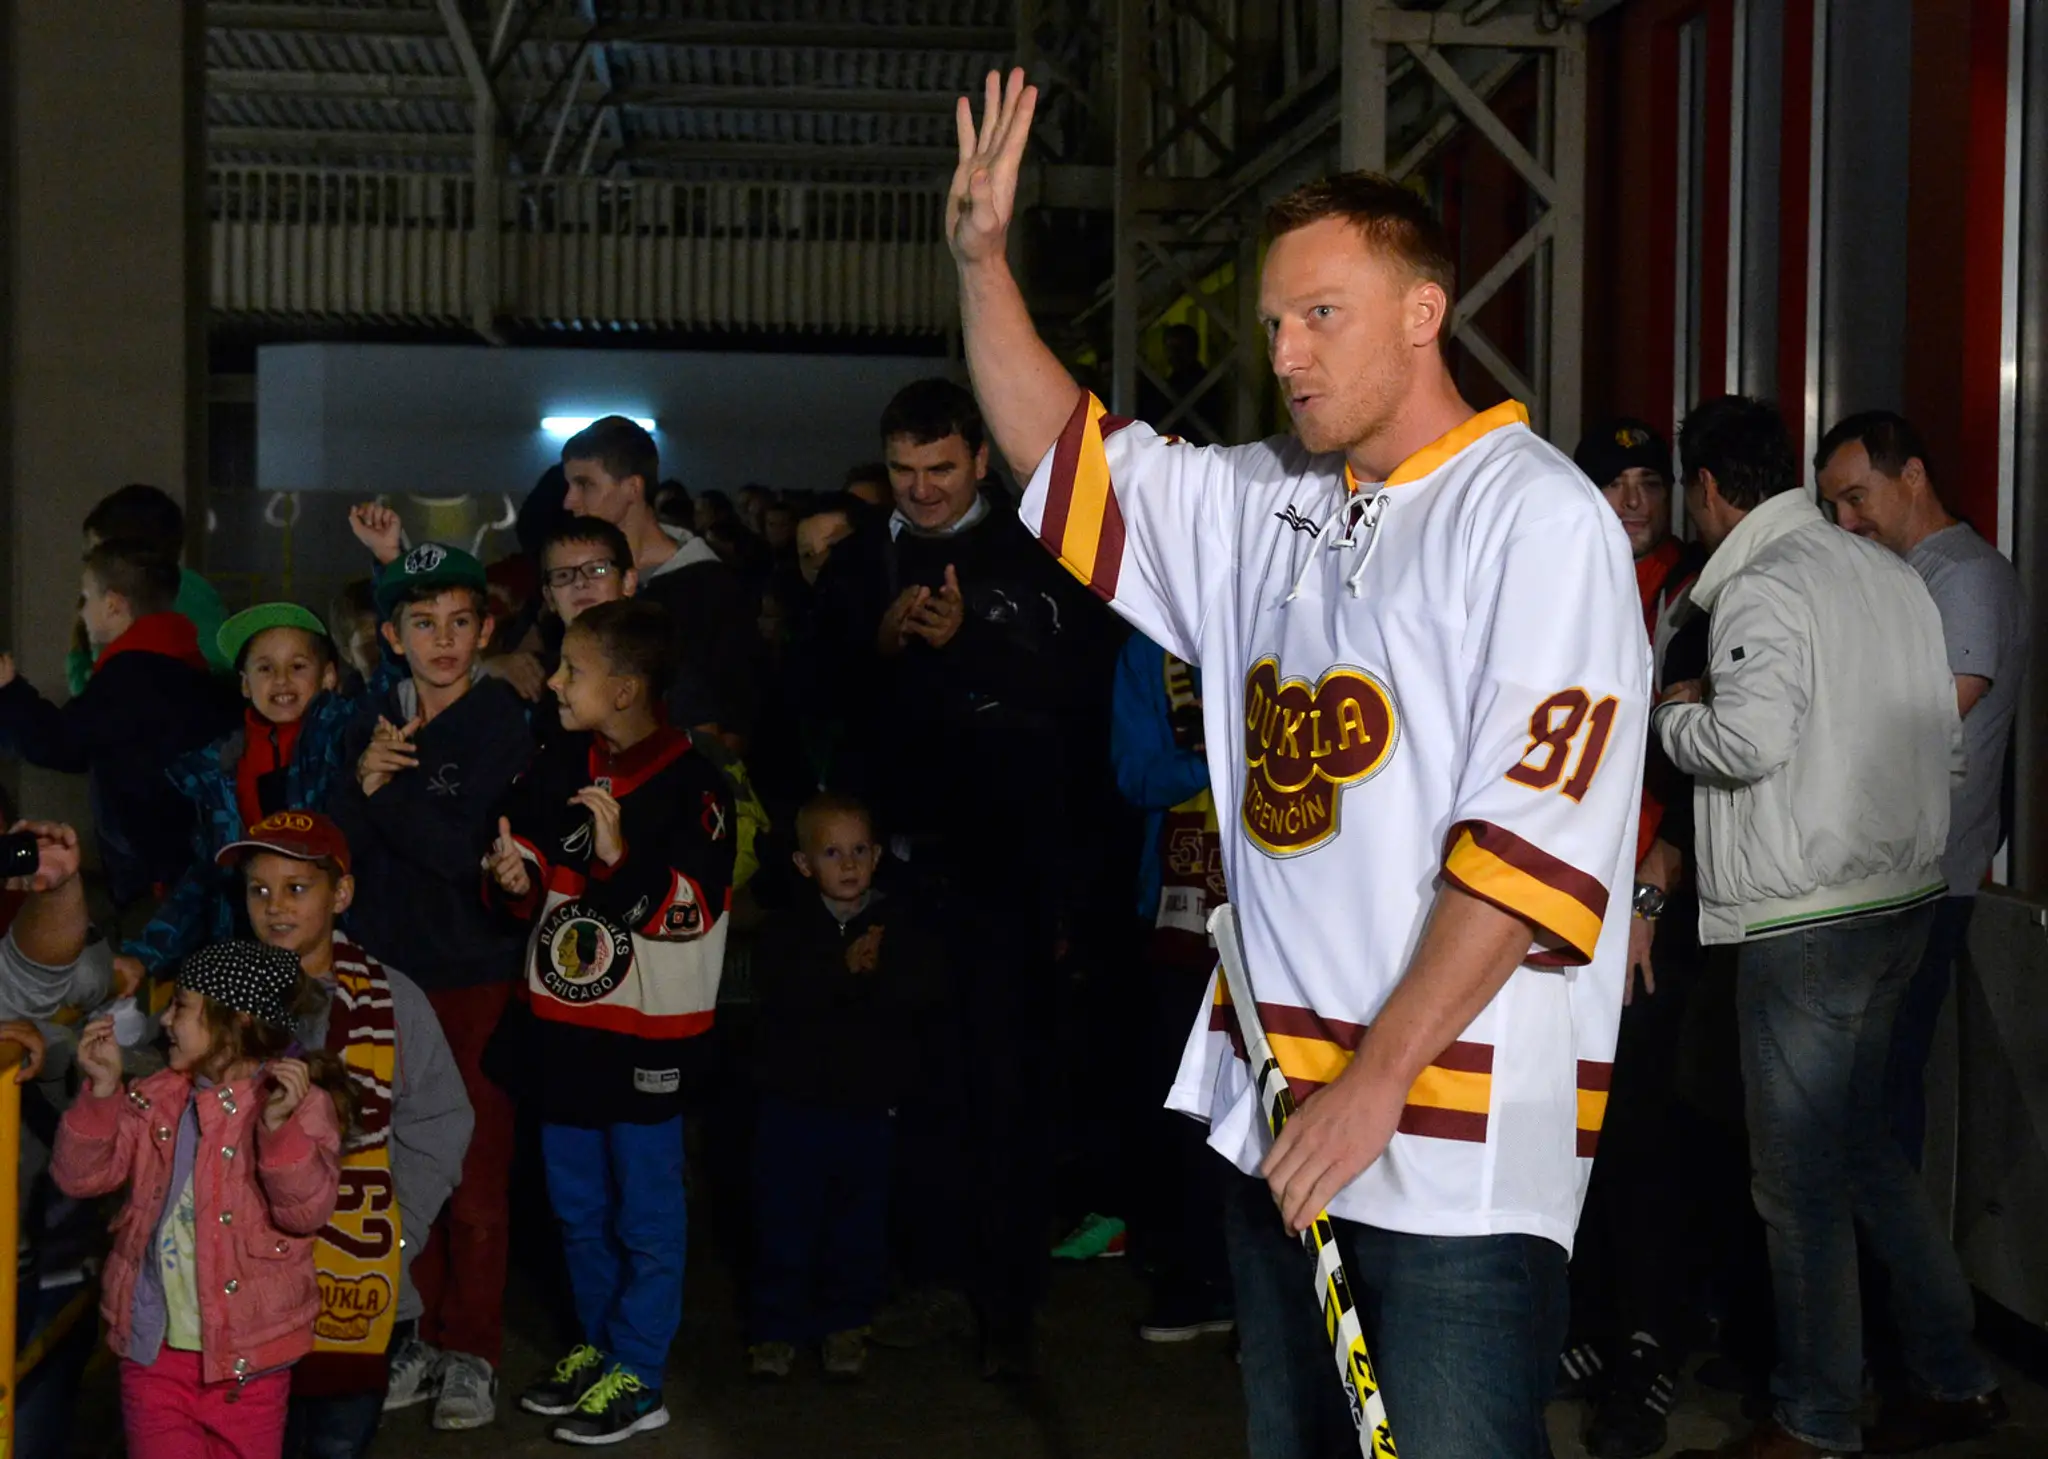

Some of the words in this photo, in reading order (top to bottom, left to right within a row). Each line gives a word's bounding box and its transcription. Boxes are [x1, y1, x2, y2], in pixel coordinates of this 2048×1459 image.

[1247, 682, 1371, 759] DUKLA
[1504, 686, 1620, 804] 81
[1247, 778, 1326, 834] TRENČÍN
[540, 903, 583, 946] BLACK
[544, 971, 614, 1000] CHICAGO
